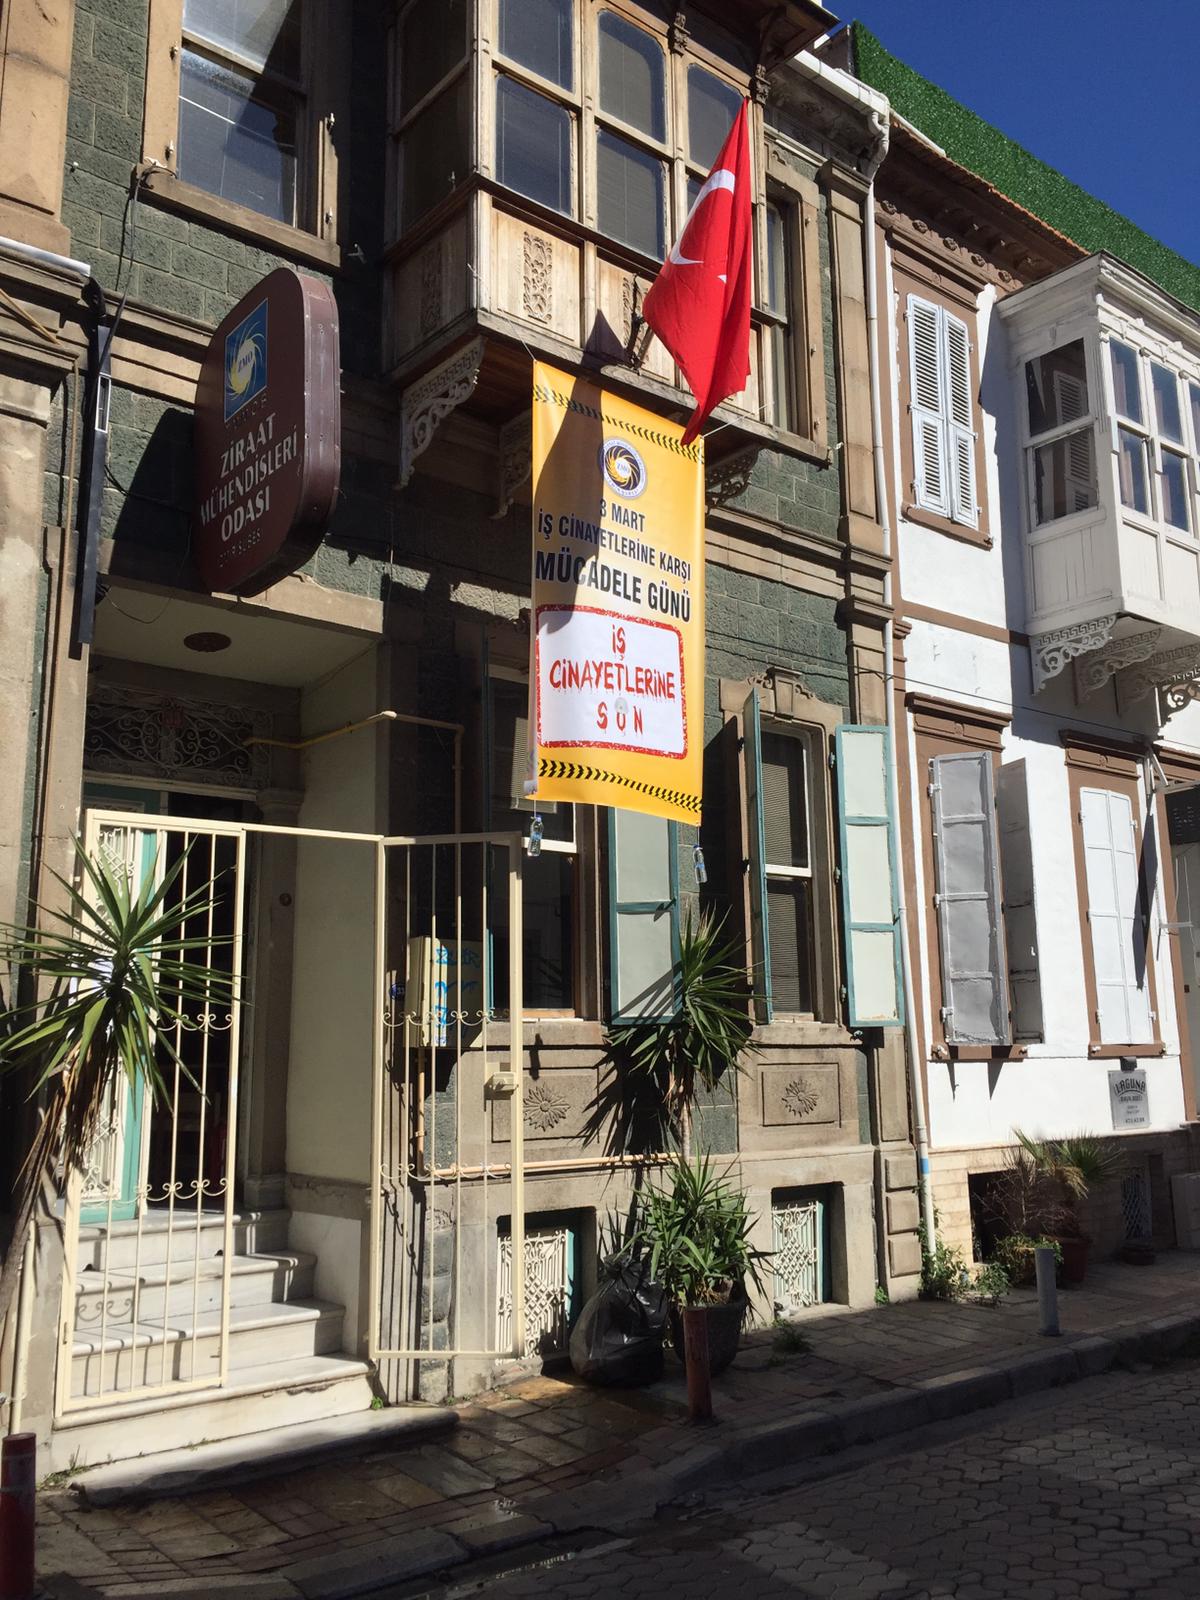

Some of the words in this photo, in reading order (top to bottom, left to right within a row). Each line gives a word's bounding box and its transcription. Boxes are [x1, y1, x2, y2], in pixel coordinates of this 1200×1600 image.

[220, 412, 276, 479] ZİRAAT
[200, 424, 297, 527] MÜHENDİSLERİ
[221, 485, 270, 542] ODASI
[611, 502, 645, 533] MART
[538, 508, 553, 540] İŞ
[558, 512, 656, 567] CİNAYETLERİNE
[659, 551, 691, 584] KARŞI
[535, 547, 642, 605] MÜCADELE
[648, 580, 691, 623] GÜNÜ
[611, 624, 626, 660] İŞ
[549, 658, 676, 699] CİNAYETLERİNE
[1115, 1078, 1146, 1094] LAGUNA
